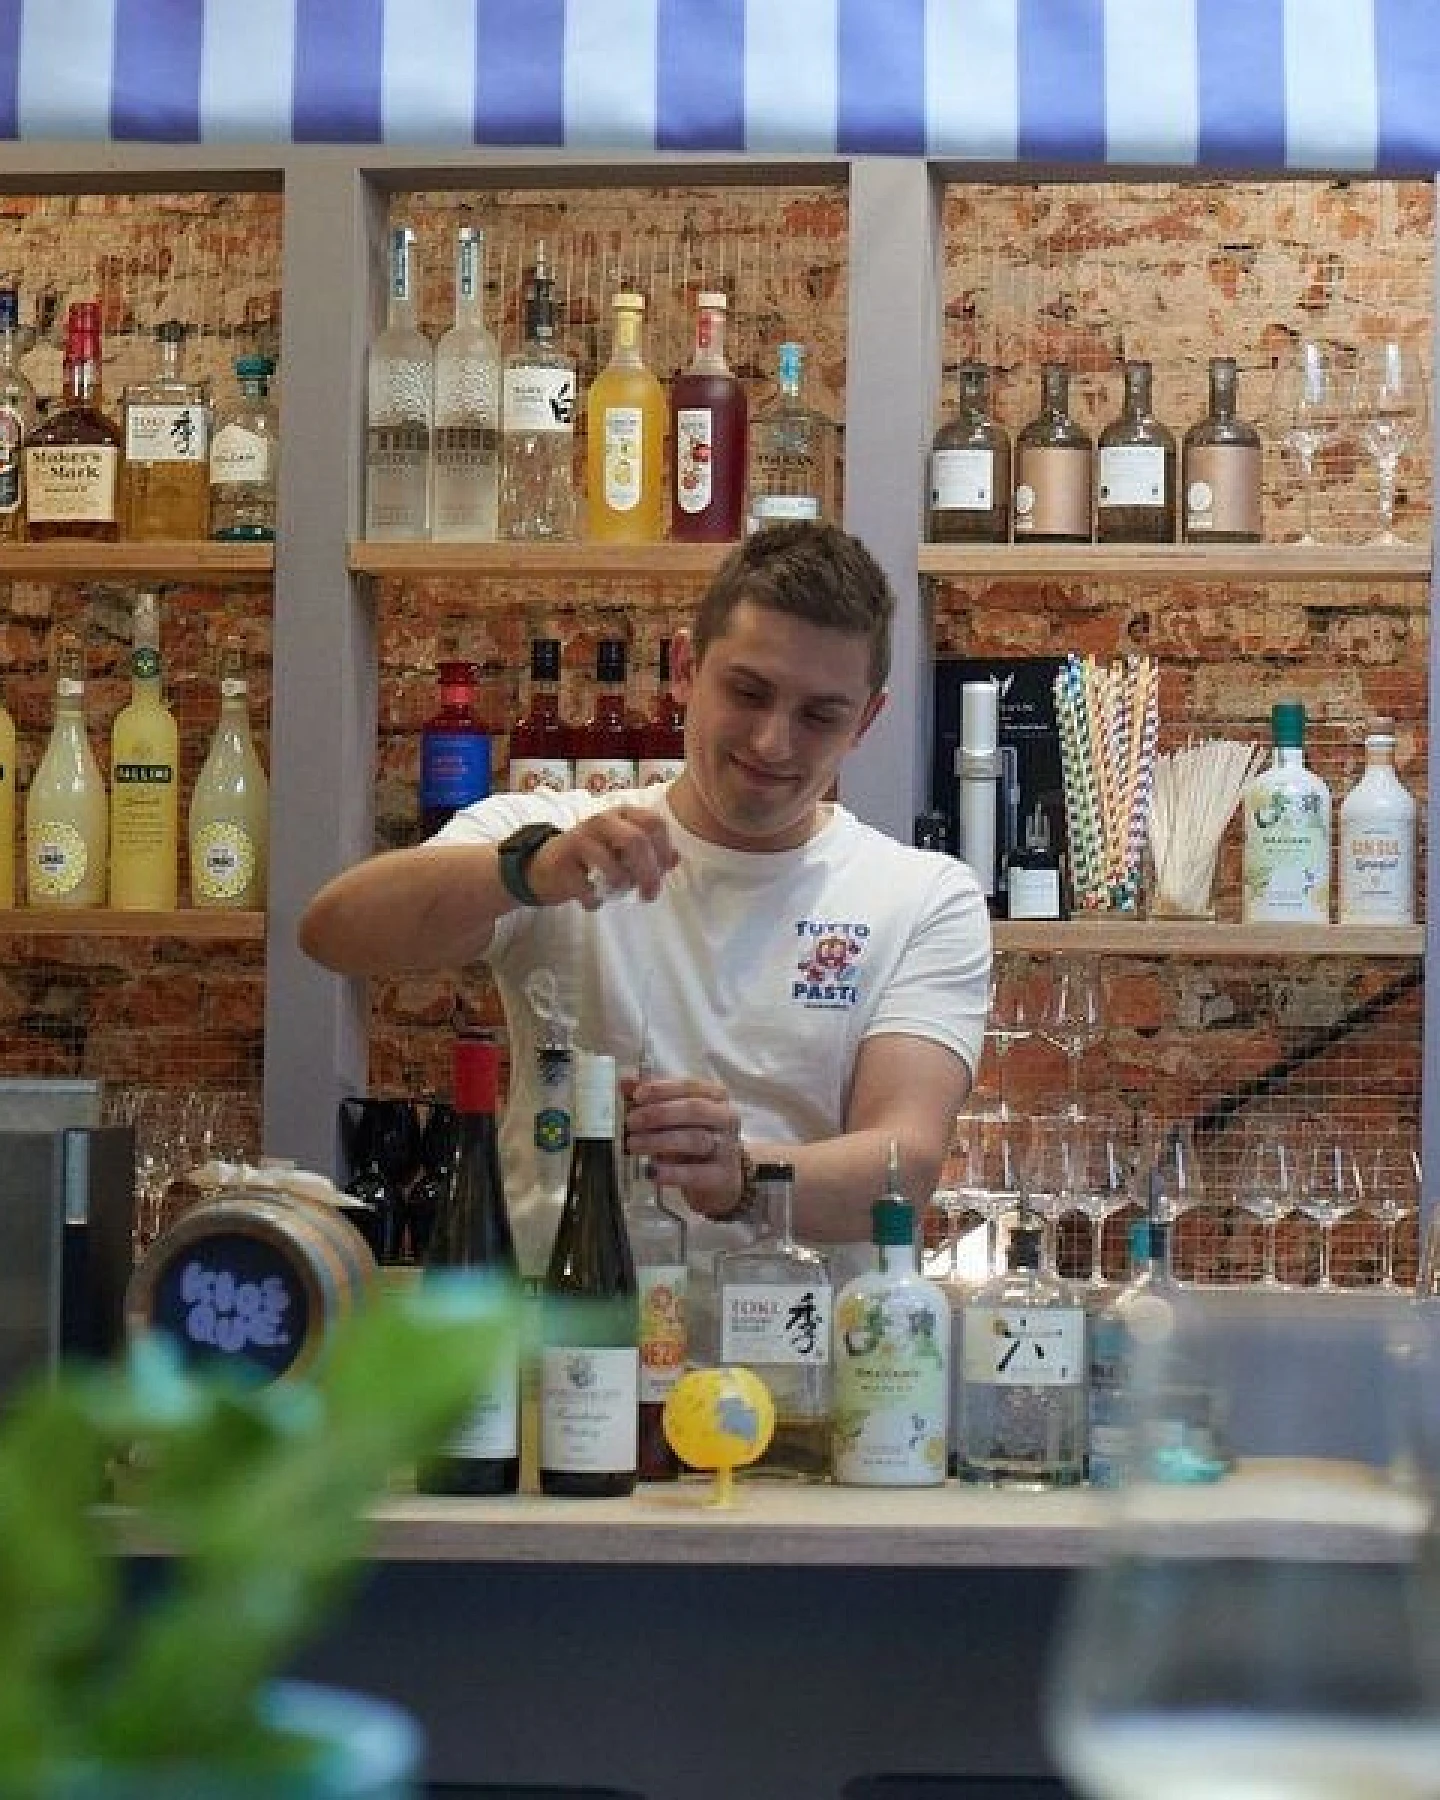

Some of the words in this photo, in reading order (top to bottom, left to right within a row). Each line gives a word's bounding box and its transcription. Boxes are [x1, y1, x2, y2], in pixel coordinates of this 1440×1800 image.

[50, 465, 100, 480] Mark
[795, 920, 870, 938] TUTTO
[731, 1300, 781, 1315] TOKI
[785, 1292, 824, 1355] 季
[996, 1318, 1064, 1372] 六
